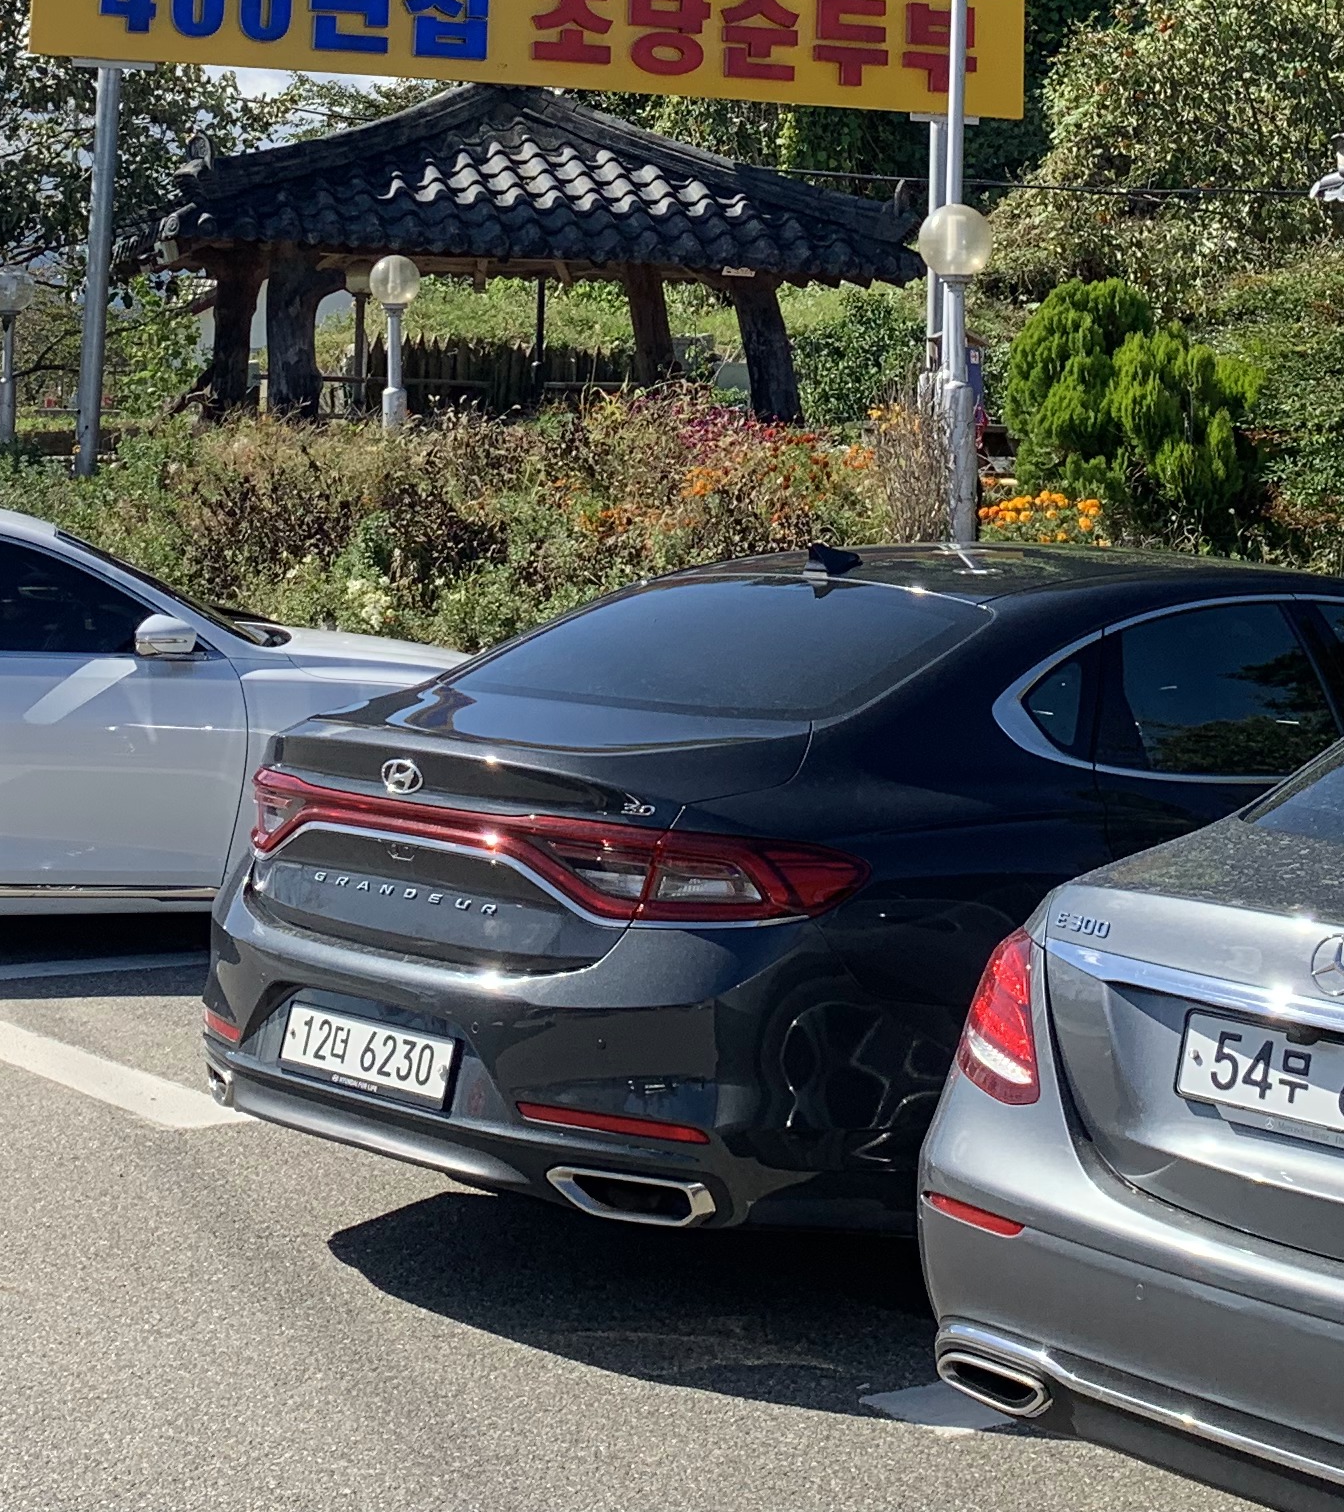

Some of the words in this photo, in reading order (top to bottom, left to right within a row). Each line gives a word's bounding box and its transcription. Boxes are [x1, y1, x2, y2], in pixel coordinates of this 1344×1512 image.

[314, 871, 499, 917] GRANDEUR
[302, 1015, 351, 1064] 12더
[359, 1031, 435, 1086] 6230
[1210, 1031, 1312, 1104] 54무
